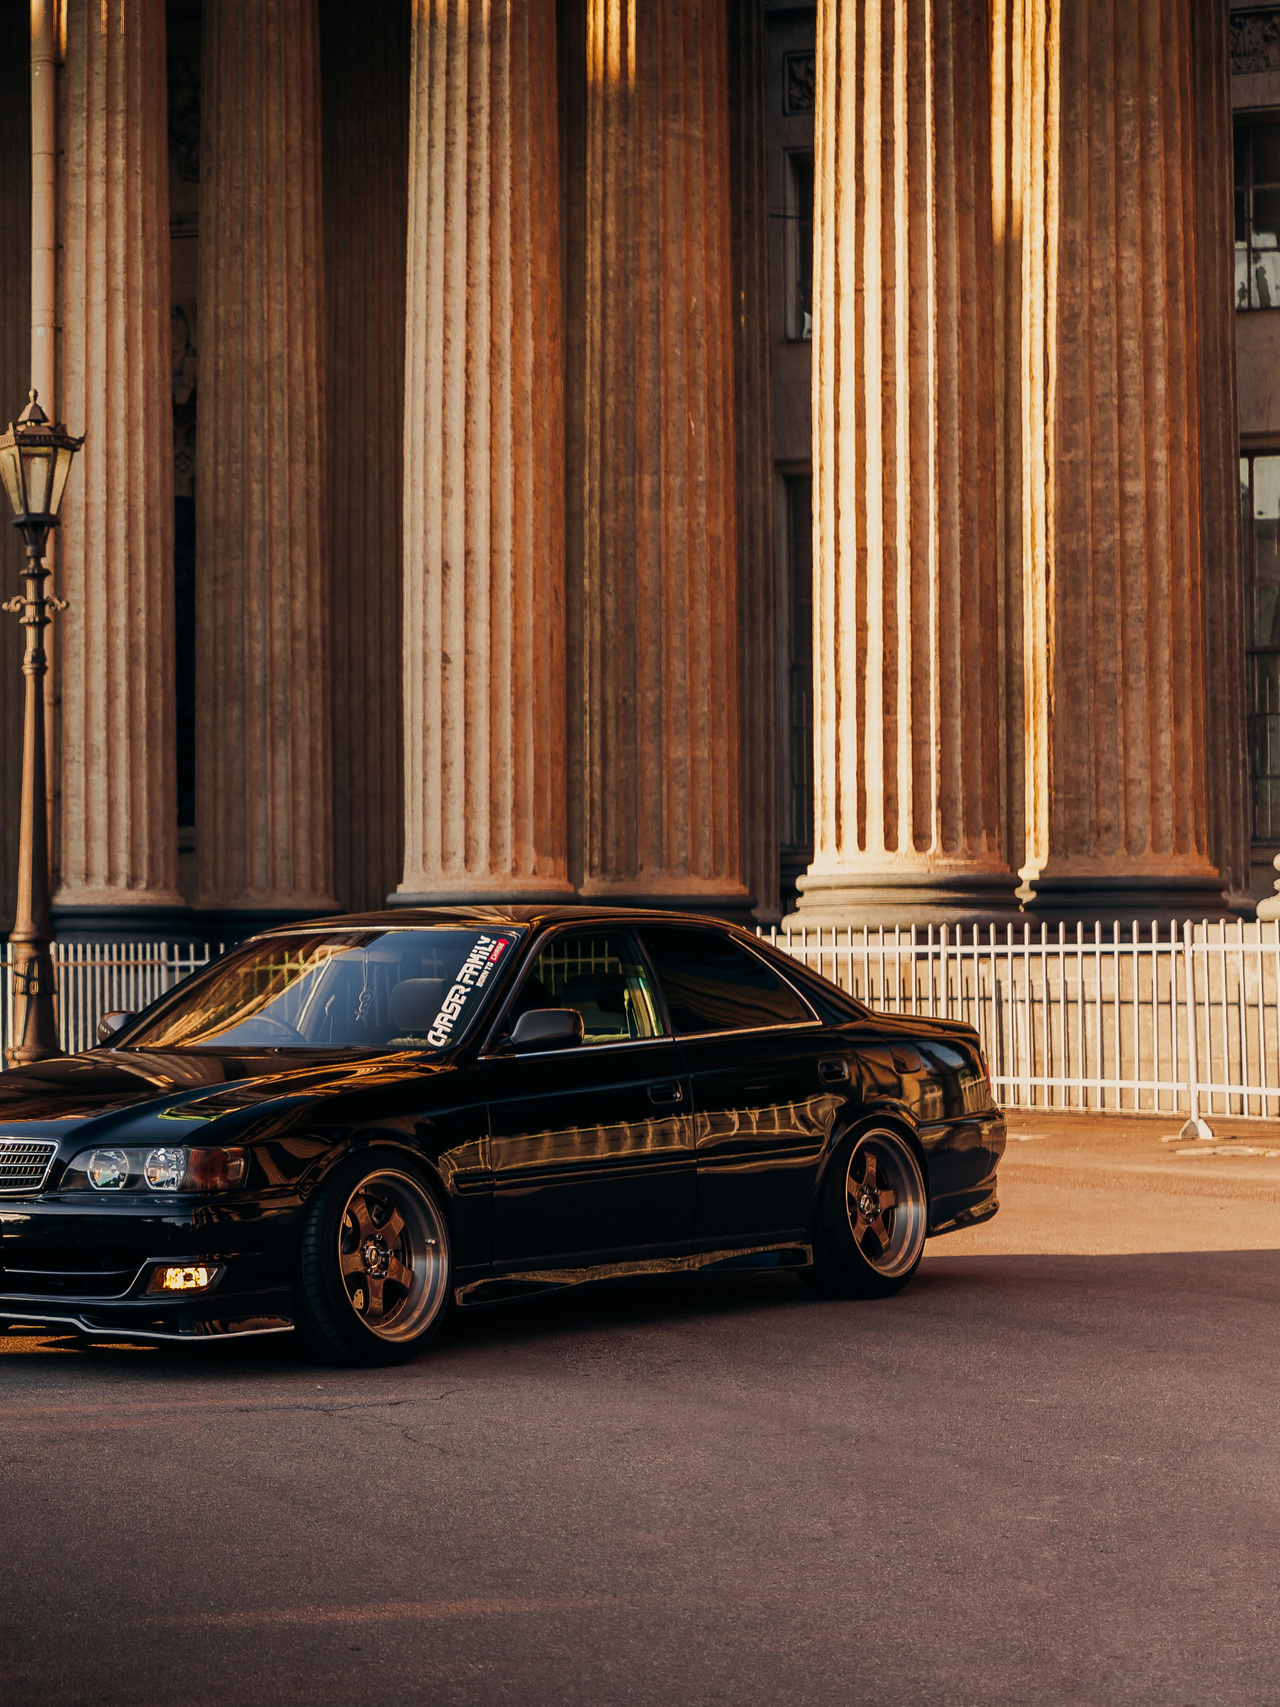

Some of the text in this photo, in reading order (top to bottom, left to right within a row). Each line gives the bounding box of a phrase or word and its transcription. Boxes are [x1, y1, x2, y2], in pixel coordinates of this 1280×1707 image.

[476, 942, 505, 988] BORN TO CHASE
[427, 984, 471, 1046] CHASER
